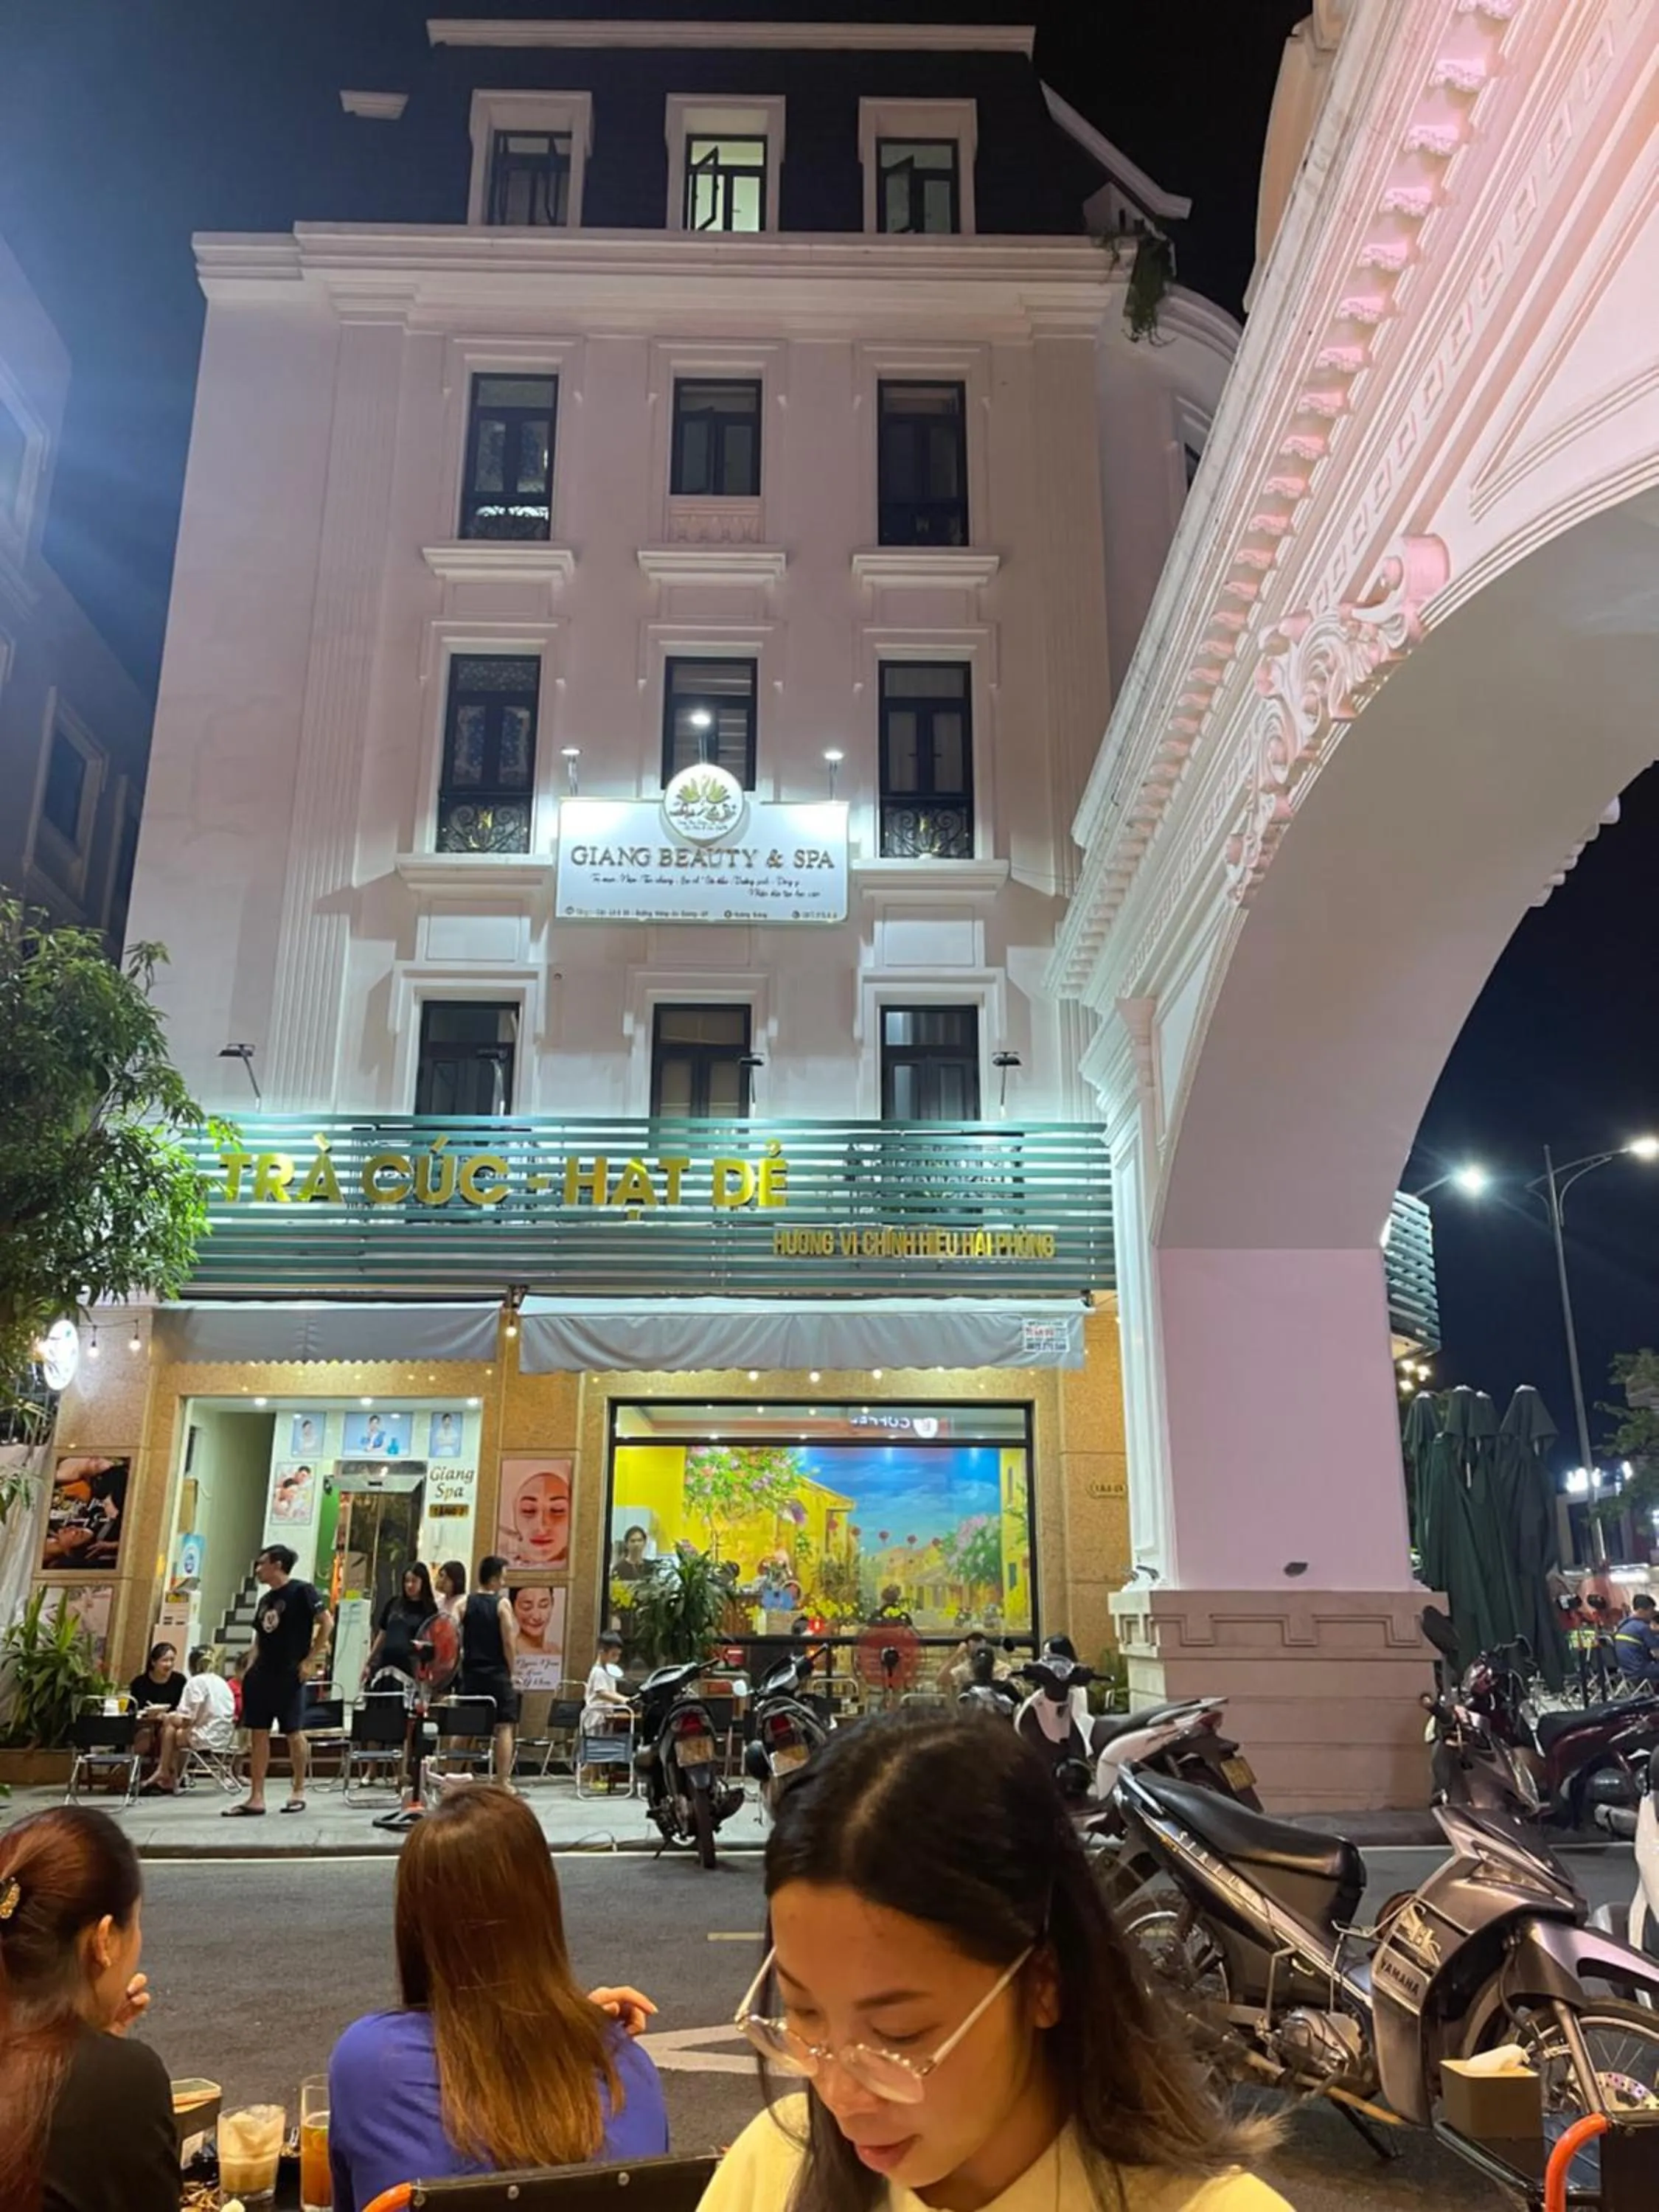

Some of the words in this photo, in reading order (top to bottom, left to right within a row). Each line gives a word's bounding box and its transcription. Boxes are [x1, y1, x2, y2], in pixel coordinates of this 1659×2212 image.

[571, 845, 652, 867] GIANG
[658, 846, 759, 869] BEAUTY
[766, 849, 784, 869] &
[793, 849, 835, 869] SPA
[219, 1133, 345, 1203] TRÀ
[361, 1135, 511, 1206] CÚC
[563, 1155, 691, 1221] HẠT
[430, 1466, 474, 1484] Giang
[435, 1482, 464, 1501] Spa
[1380, 1958, 1420, 1996] YAMAHA
